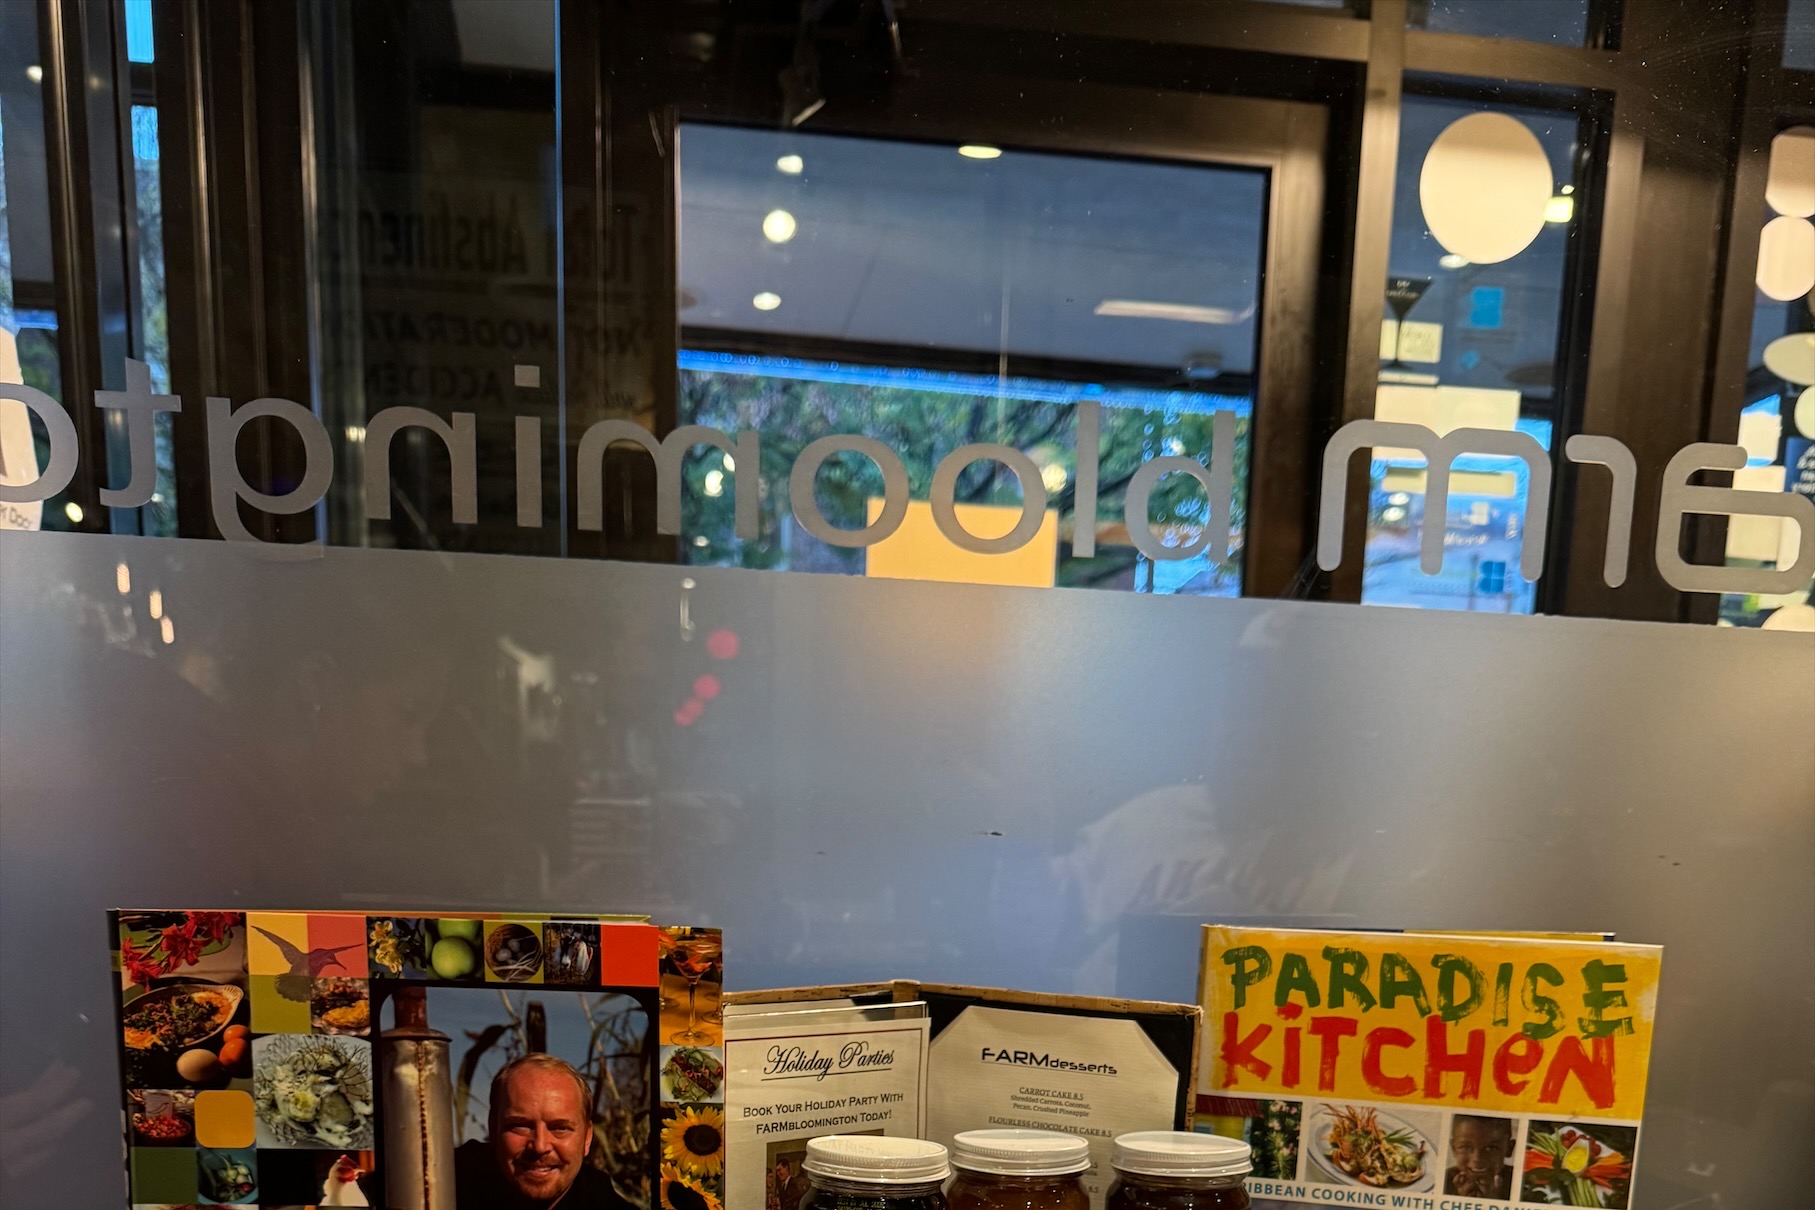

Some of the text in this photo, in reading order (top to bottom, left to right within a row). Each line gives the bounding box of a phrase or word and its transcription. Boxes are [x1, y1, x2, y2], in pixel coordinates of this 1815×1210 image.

[1220, 944, 1636, 1041] PARADISE
[763, 1041, 894, 1081] Holiday Parties
[982, 1048, 1117, 1075] FARMdesserts
[1011, 1095, 1038, 1103] Shredded
[1019, 1087, 1084, 1101] CARROT CAKE 8.5
[1033, 1105, 1058, 1114] Crushed
[1060, 1108, 1089, 1118] Pineapple
[989, 1116, 1031, 1128] FLOURLESS
[1032, 1121, 1078, 1134] CHOCOLATE
[1079, 1127, 1101, 1137] CAKE
[1311, 1188, 1386, 1206] COOKING
[1392, 1195, 1433, 1210] WITH
